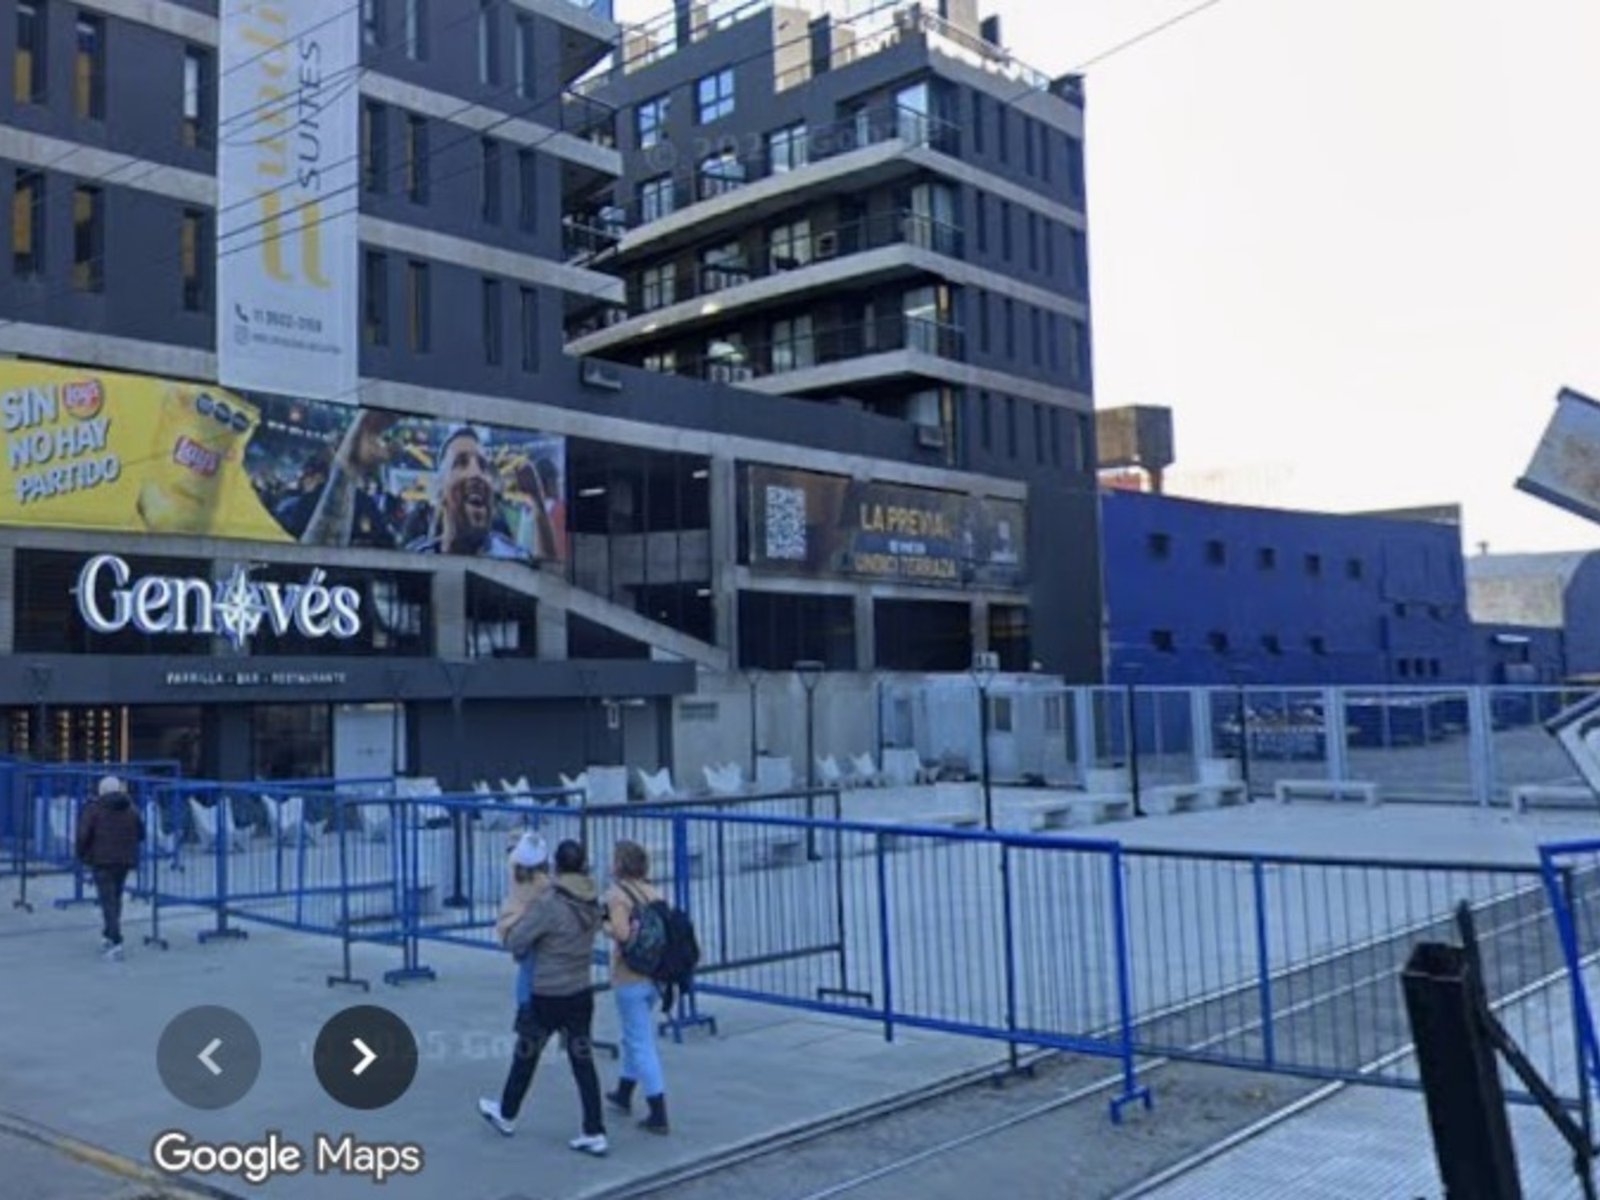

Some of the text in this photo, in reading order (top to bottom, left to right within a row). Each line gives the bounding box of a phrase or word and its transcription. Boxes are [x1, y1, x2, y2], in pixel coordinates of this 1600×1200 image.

[299, 39, 321, 191] SUITES
[2, 383, 59, 432] SIN
[9, 416, 111, 470] NO HAY
[17, 453, 121, 504] PARTIDO
[860, 503, 884, 533] LA
[167, 671, 347, 685] PARRILLA BAR RESTAURANTE
